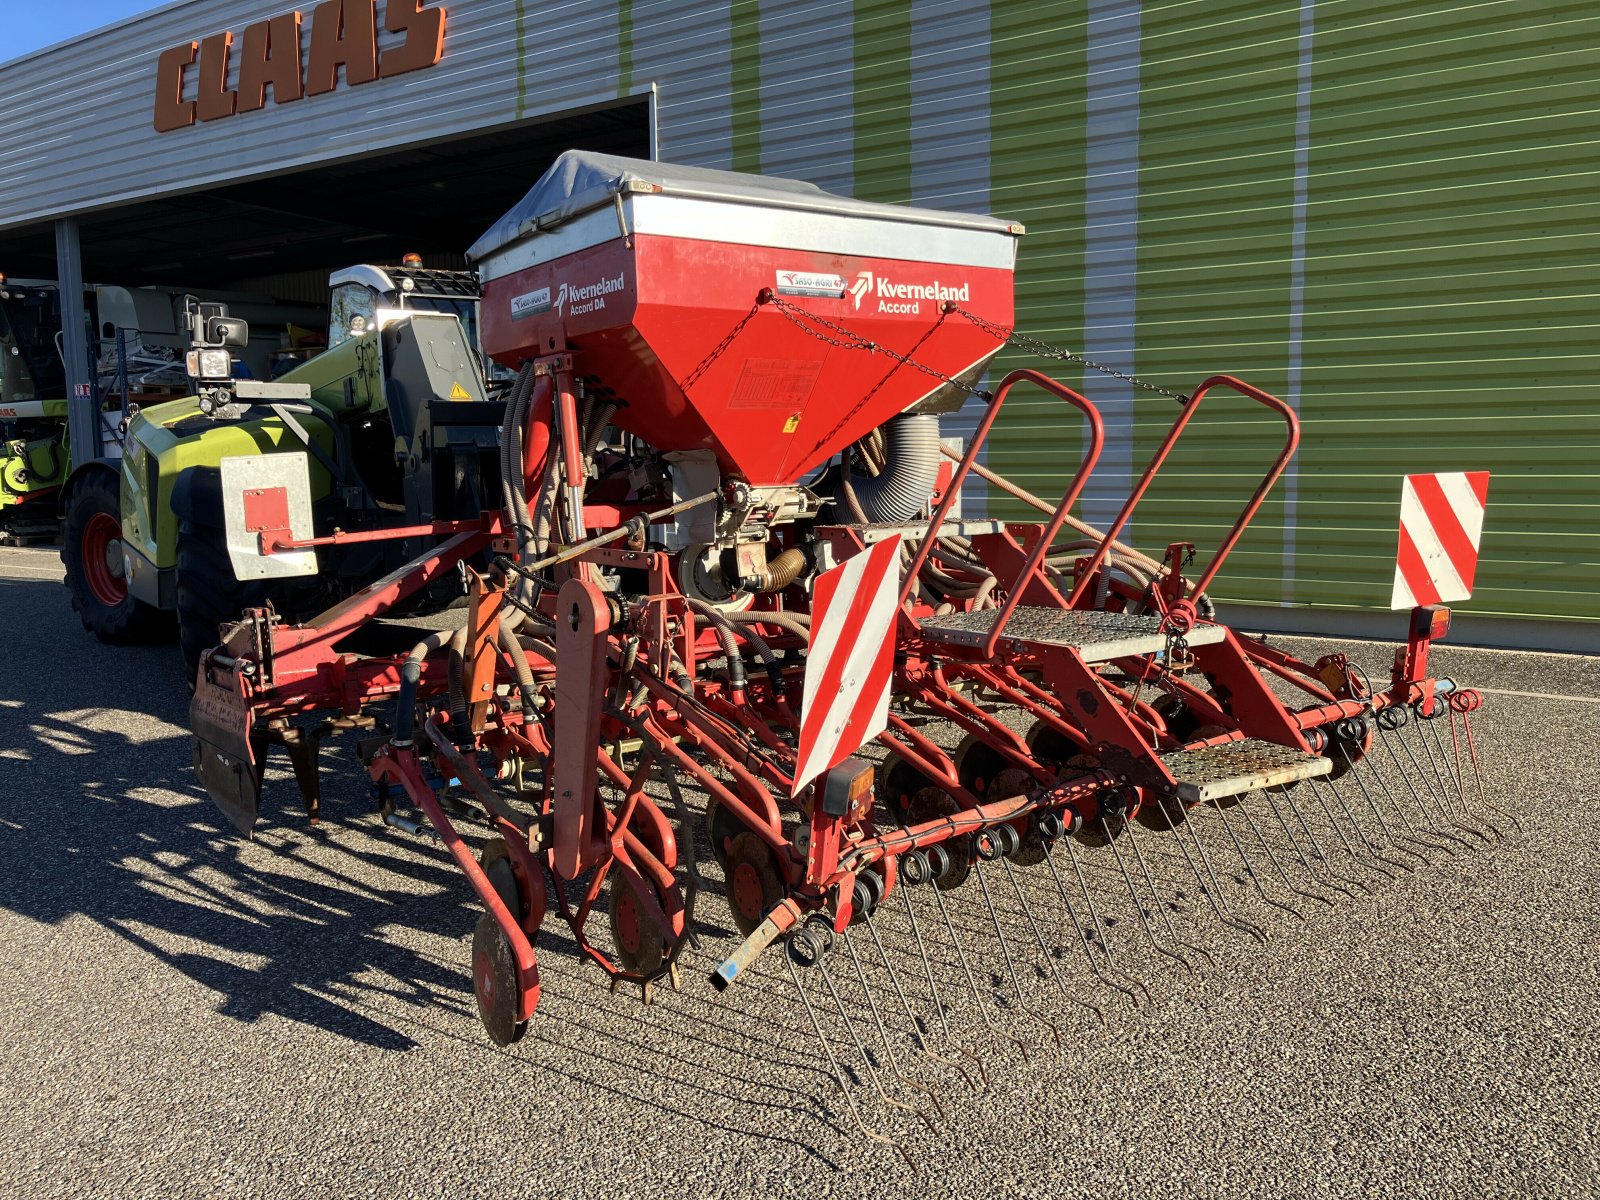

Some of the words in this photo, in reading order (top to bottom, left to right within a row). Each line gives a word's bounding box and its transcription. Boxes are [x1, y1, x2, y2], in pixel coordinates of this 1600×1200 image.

[153, 0, 447, 132] CLAAS
[569, 271, 625, 303] Kverneland
[876, 277, 970, 302] Kverneland
[570, 300, 595, 317] Accord
[594, 298, 606, 311] DA
[878, 300, 920, 315] Accord
